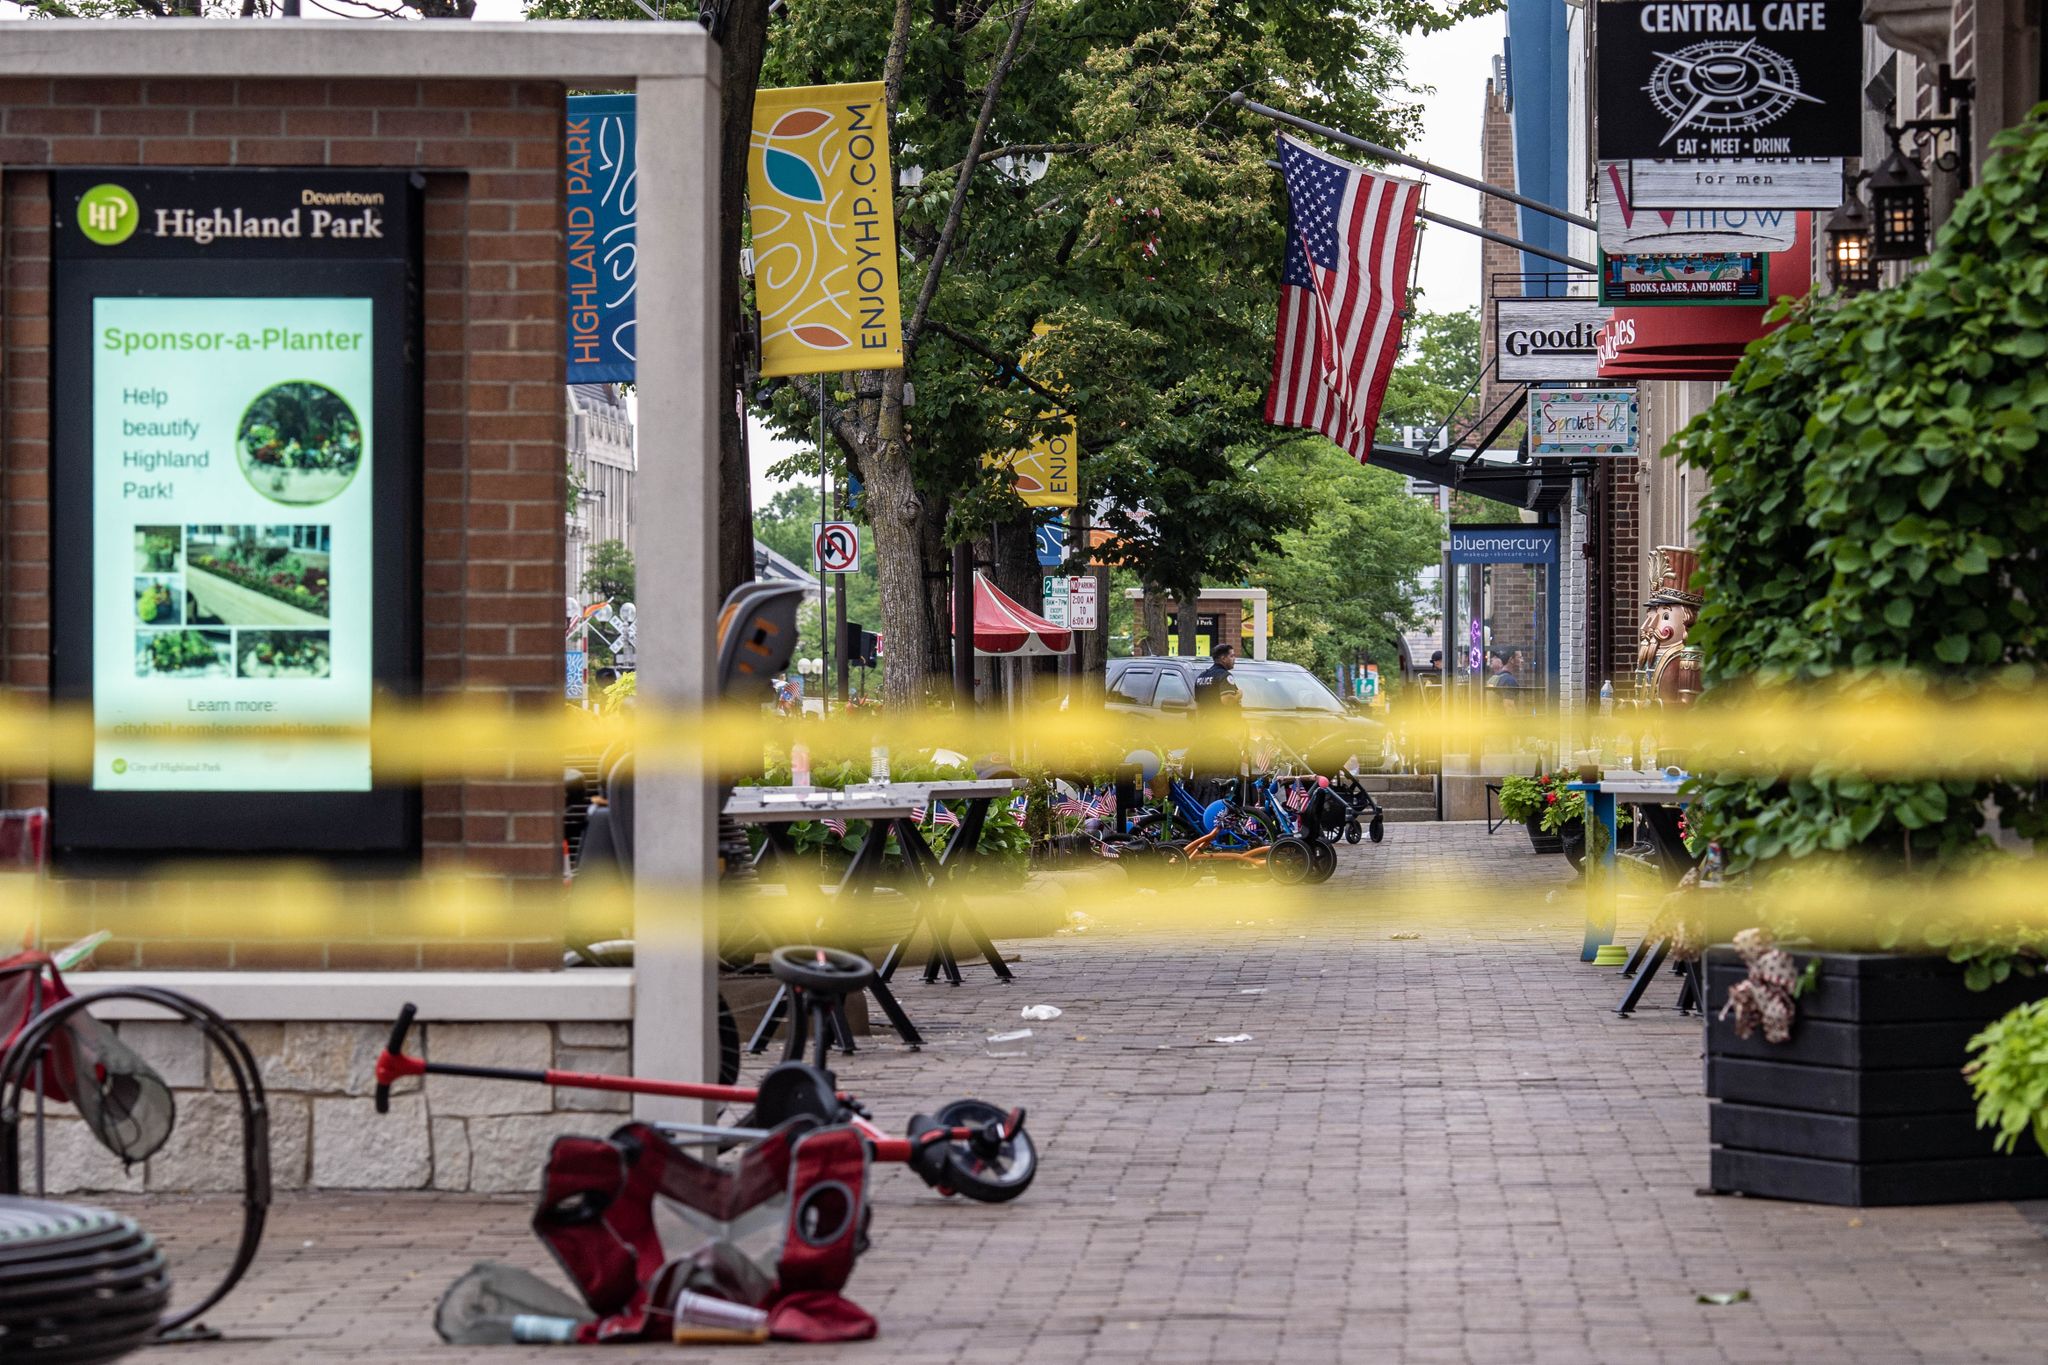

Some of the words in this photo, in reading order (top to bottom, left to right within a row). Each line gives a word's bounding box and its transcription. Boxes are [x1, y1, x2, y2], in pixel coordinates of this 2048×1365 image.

[1640, 4, 1756, 32] CENTRAL
[1762, 3, 1826, 31] CAFE
[1677, 139, 1698, 154] EAT
[1711, 138, 1741, 154] MEET
[1753, 138, 1791, 153] DRINK
[566, 118, 593, 195] PARK
[1696, 172, 1725, 184] for
[1736, 175, 1773, 184] men
[302, 189, 384, 206] Downtown
[155, 208, 300, 244] Highland
[311, 207, 384, 238] Park
[846, 103, 888, 350] ENJOYHP.COM
[568, 206, 600, 363] HIGHLAND
[1630, 283, 1659, 294] BOOKS,
[1660, 282, 1690, 293] GAMES,
[1690, 282, 1708, 292] AND
[1709, 281, 1736, 292] MORE!
[103, 327, 363, 355] Sponsor-a-Planter
[123, 387, 168, 409] Help
[1596, 403, 1626, 432] Kids
[123, 418, 200, 441] beautify
[123, 450, 209, 472] Highland
[123, 481, 173, 499] Park!
[1453, 535, 1552, 553] bluemercury
[1045, 580, 1052, 594] 2
[1072, 596, 1084, 605] 2:00
[1086, 596, 1094, 605] AM
[1080, 606, 1087, 615] TO
[1072, 616, 1084, 626] 6:00
[1086, 616, 1094, 625] AM
[1196, 676, 1214, 686] POLICE
[187, 698, 230, 712] Learn
[235, 701, 278, 712] more:
